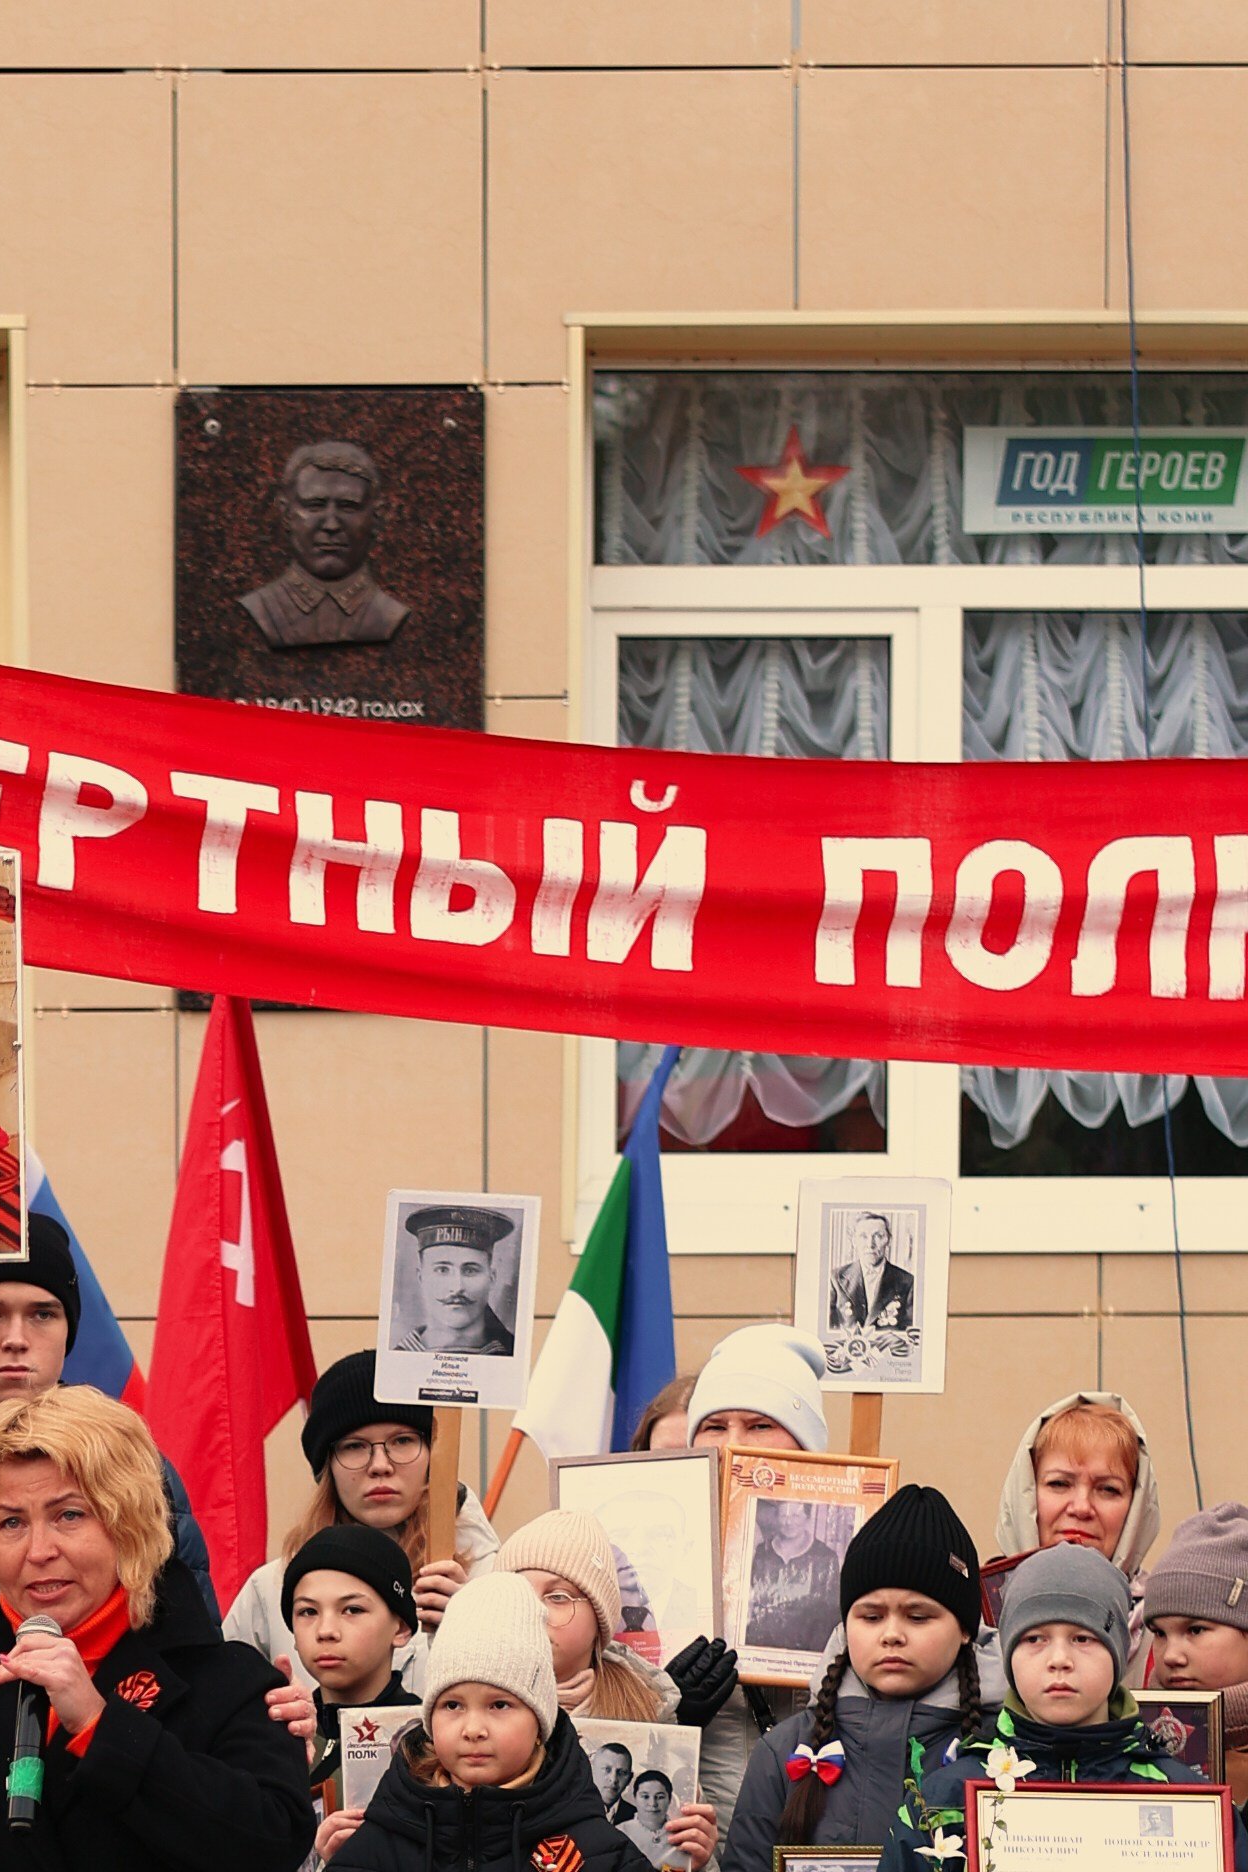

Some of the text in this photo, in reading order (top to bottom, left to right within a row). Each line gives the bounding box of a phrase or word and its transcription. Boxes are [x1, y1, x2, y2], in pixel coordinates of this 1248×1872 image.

[1011, 450, 1228, 497] ГОД ГЕРОЕВ
[347, 1750, 378, 1759] ПОЛК
